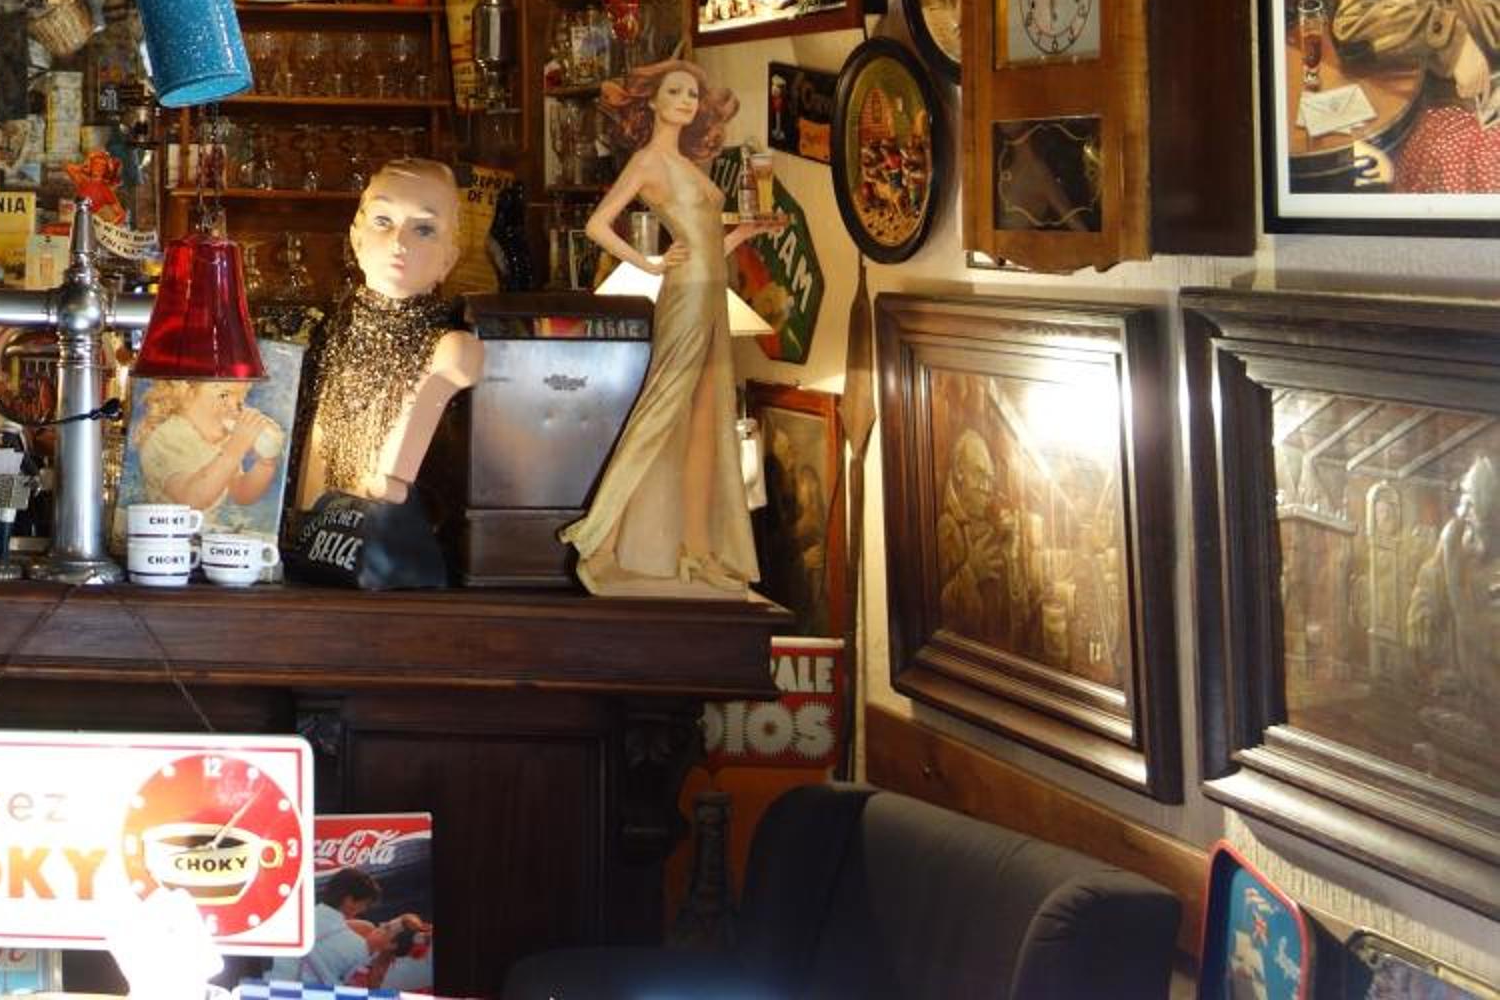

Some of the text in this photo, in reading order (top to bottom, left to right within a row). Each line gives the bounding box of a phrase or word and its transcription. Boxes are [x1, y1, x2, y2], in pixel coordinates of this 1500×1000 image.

[209, 546, 249, 557] CHOKY
[308, 529, 363, 572] BELGE
[770, 655, 834, 694] ALE
[202, 757, 222, 777] 12
[287, 841, 299, 859] 3
[174, 856, 248, 873] CHOKY
